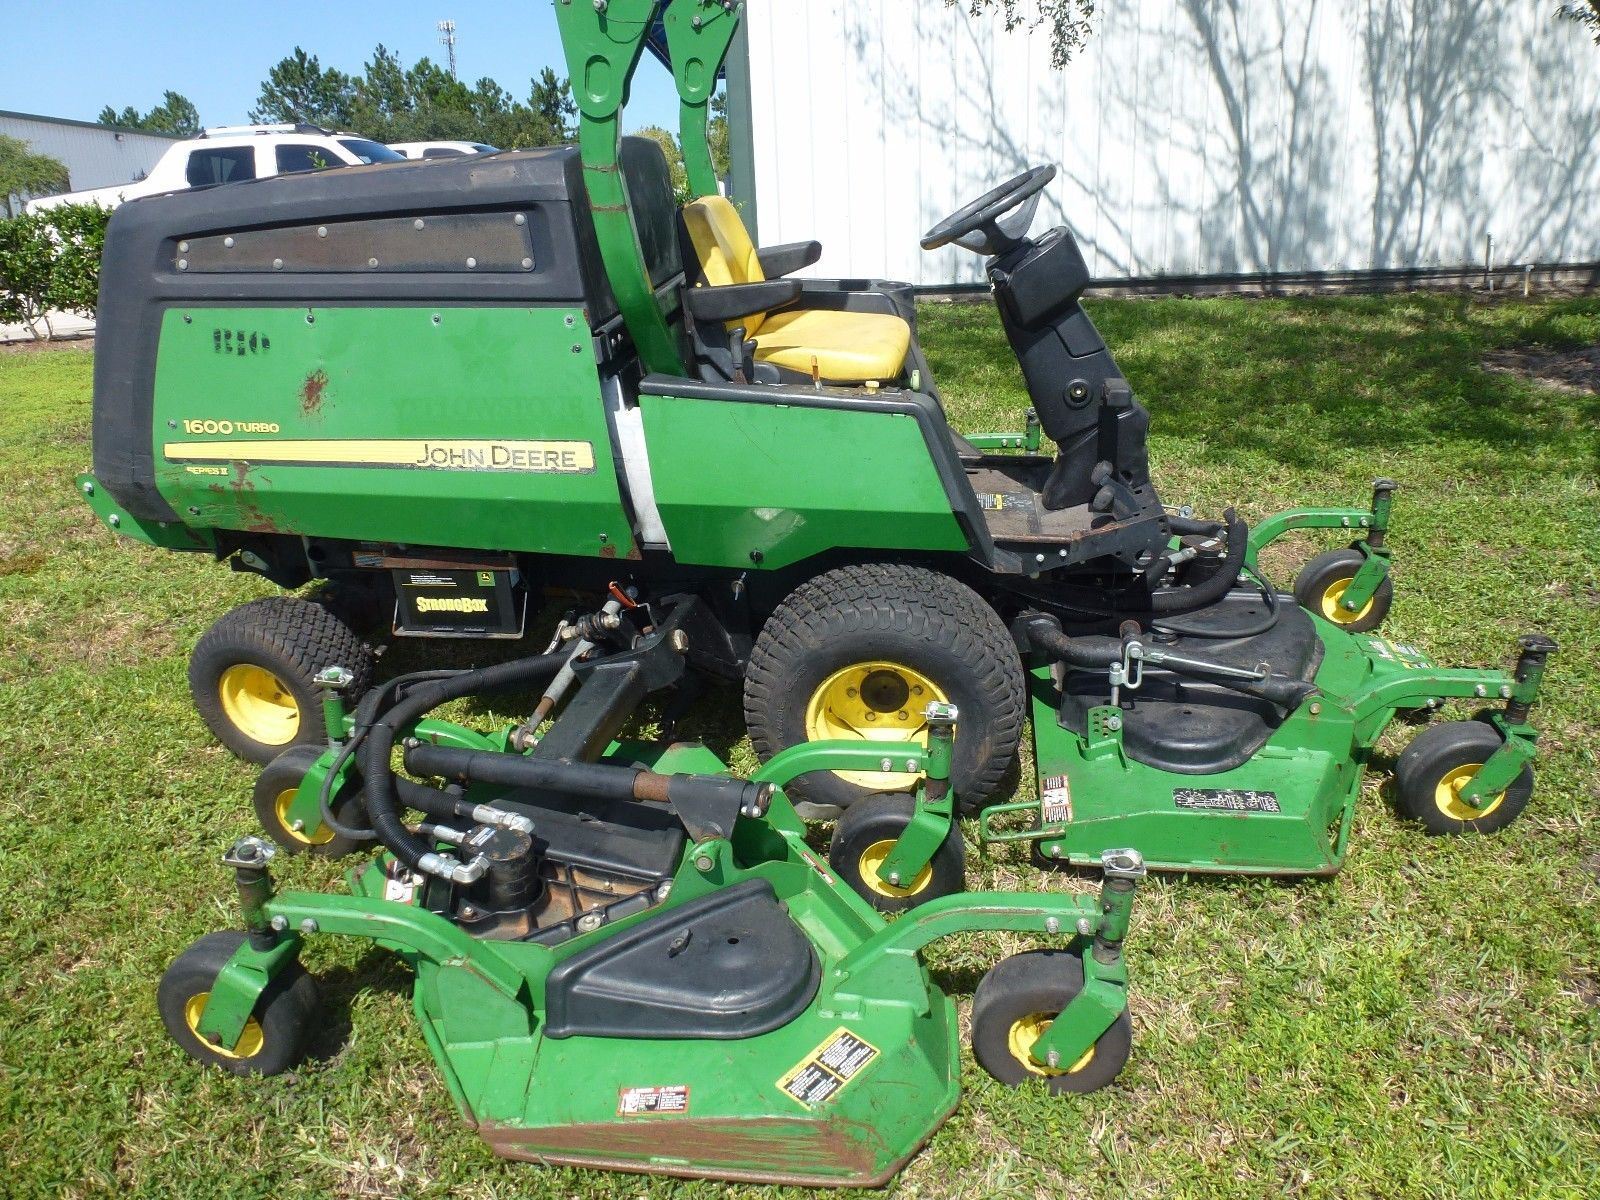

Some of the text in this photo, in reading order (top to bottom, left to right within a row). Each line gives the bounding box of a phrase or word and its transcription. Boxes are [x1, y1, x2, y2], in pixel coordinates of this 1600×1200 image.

[183, 419, 280, 435] 1600 TURBO
[416, 443, 577, 468] JOHN DEERE
